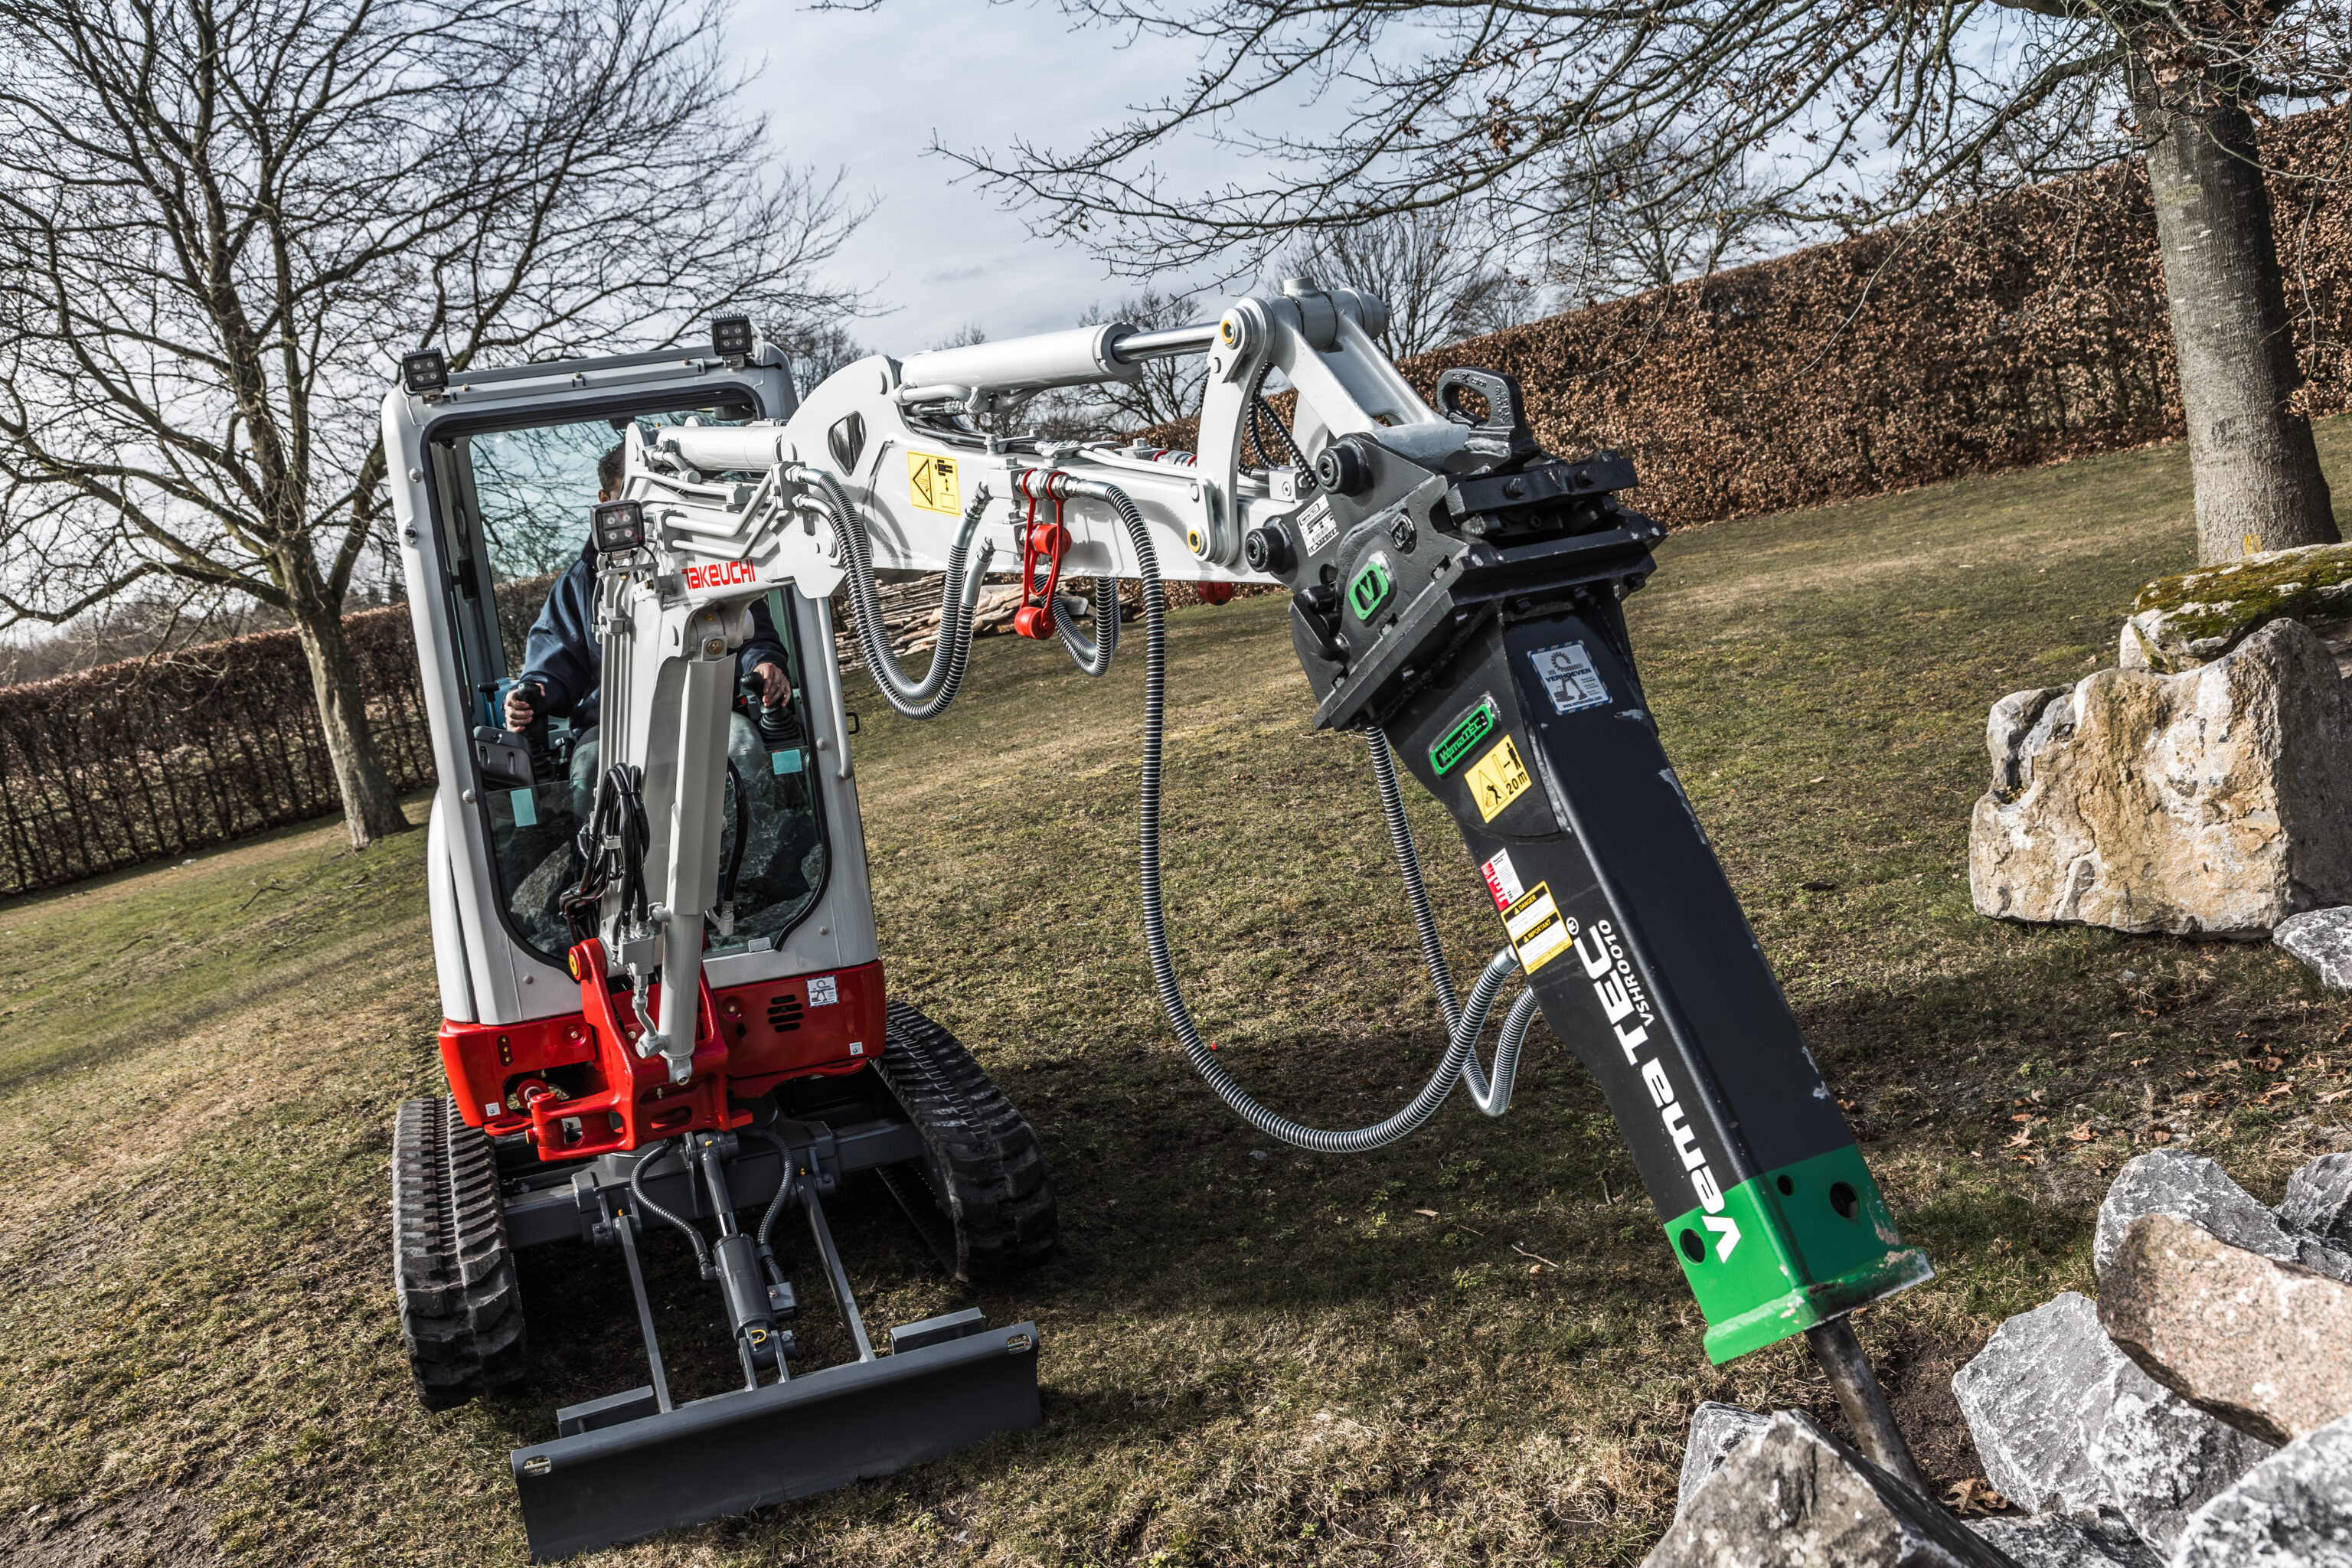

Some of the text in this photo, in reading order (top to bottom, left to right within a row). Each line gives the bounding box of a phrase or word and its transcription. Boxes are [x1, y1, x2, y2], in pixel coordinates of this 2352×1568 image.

[1544, 668, 1592, 682] VERHOEVEN
[1518, 894, 1537, 910] DANGER
[1528, 918, 1552, 939] IMPORTANT
